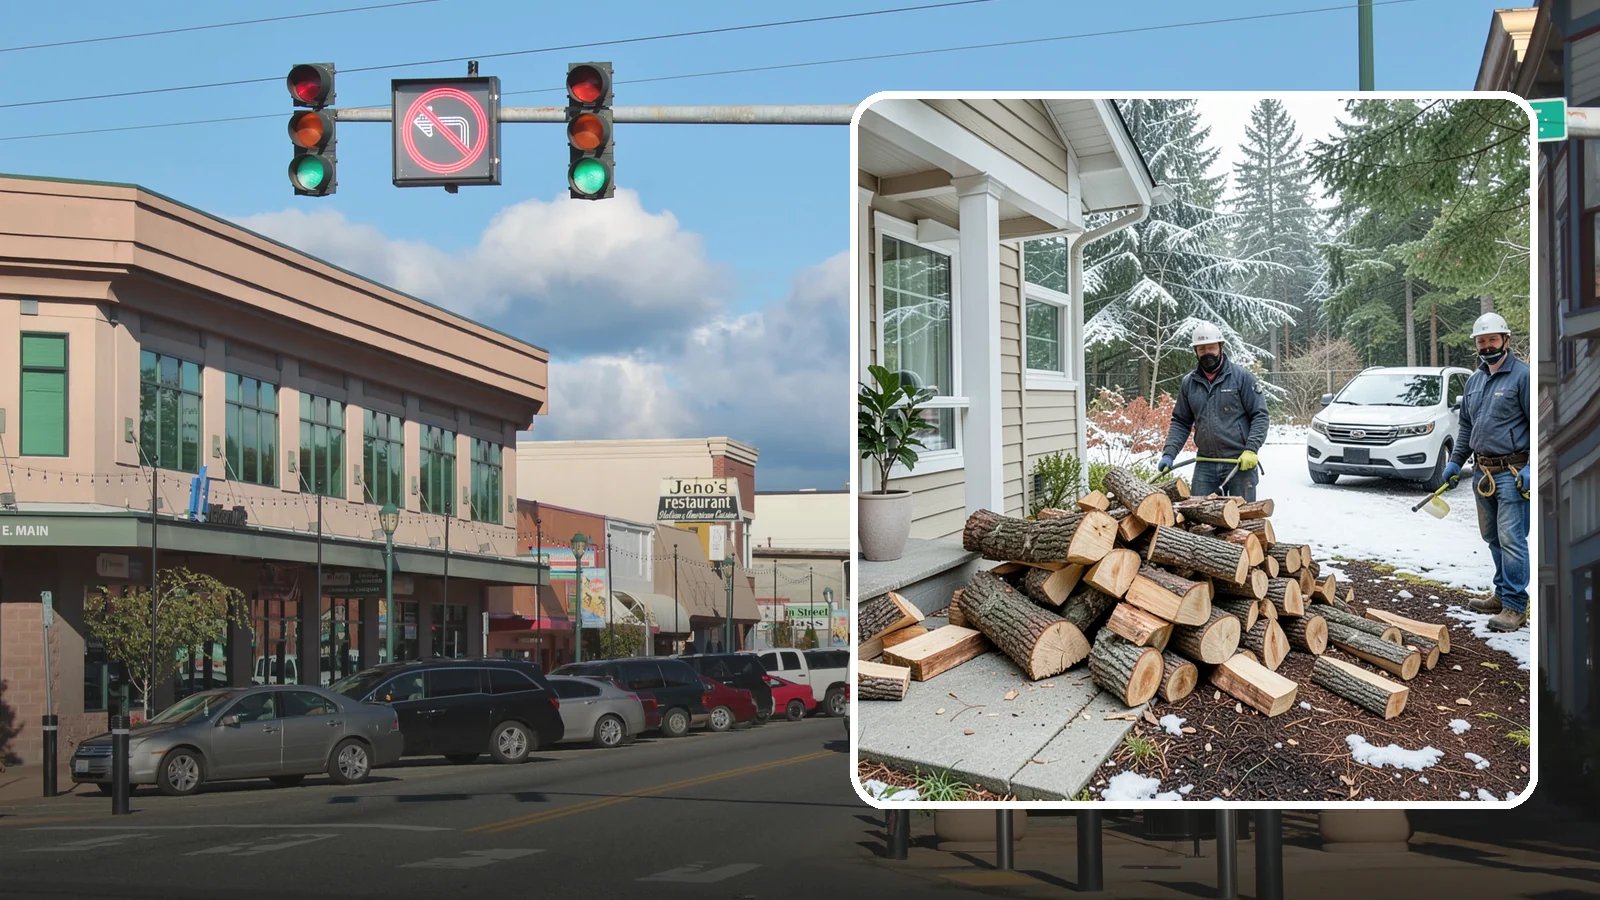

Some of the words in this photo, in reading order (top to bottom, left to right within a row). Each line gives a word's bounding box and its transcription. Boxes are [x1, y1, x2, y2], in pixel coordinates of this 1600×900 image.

[669, 479, 727, 494] Jeno's
[665, 496, 731, 509] restaurant
[658, 509, 681, 519] Italian
[686, 509, 715, 519] American
[715, 509, 738, 519] Cuisine
[2, 525, 13, 536] E.
[15, 525, 49, 536] MAIN
[797, 607, 829, 616] Street
[791, 619, 824, 627] lass
